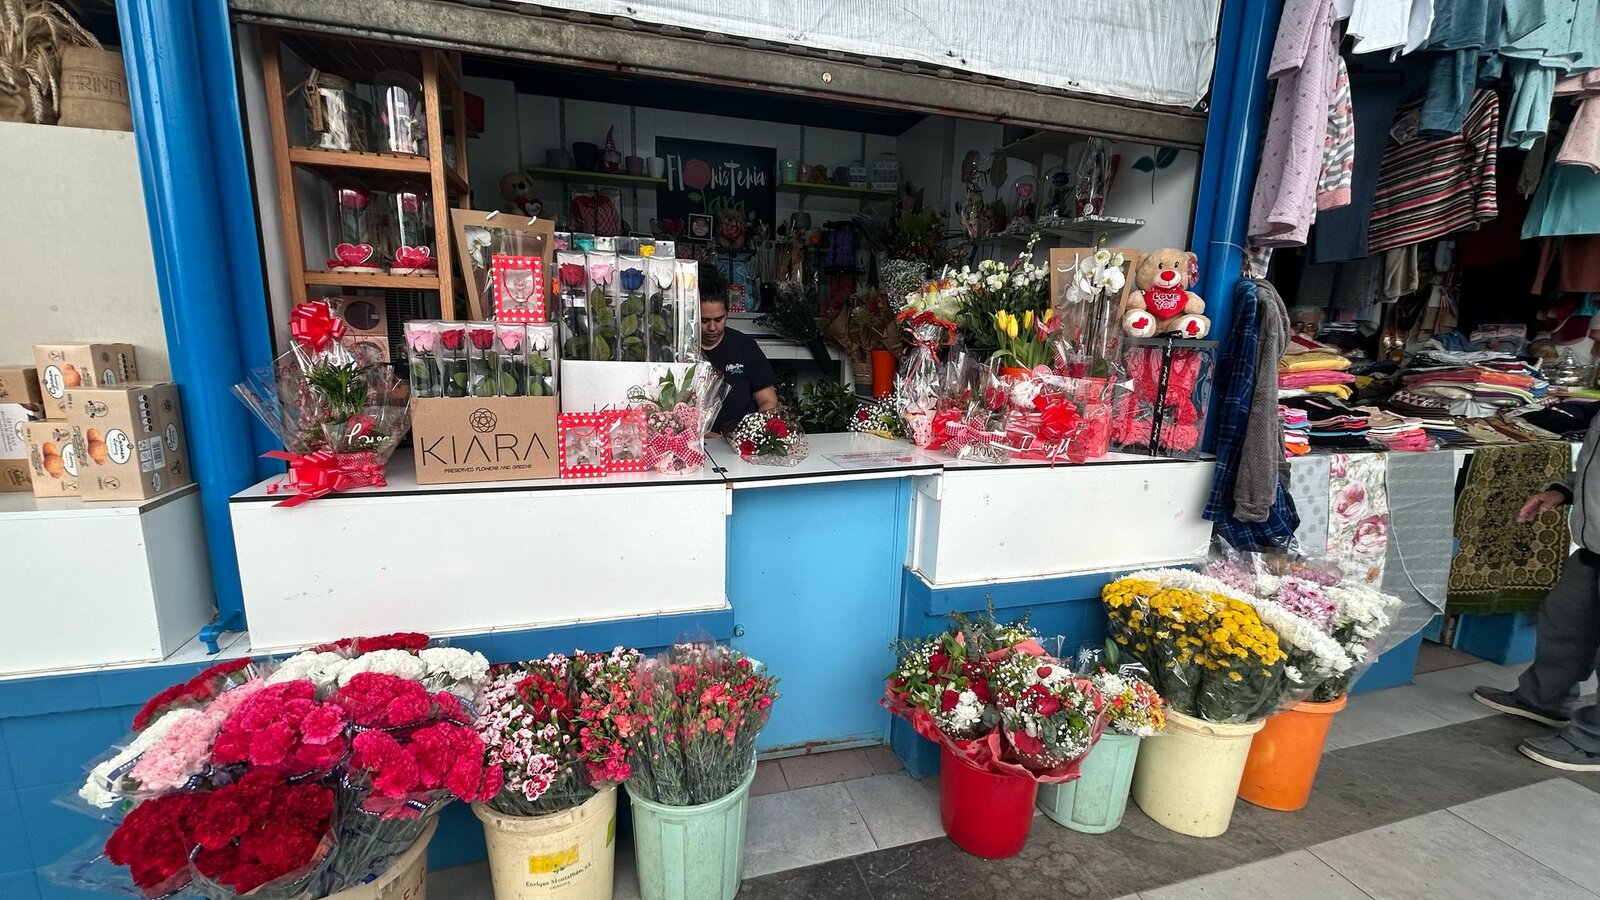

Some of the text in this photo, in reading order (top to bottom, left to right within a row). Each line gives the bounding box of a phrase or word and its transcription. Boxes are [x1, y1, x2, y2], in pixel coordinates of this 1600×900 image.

[1153, 293, 1180, 301] LOVE
[1155, 300, 1177, 310] YOU
[421, 432, 550, 466] KIARA
[525, 880, 550, 888] Enrique
